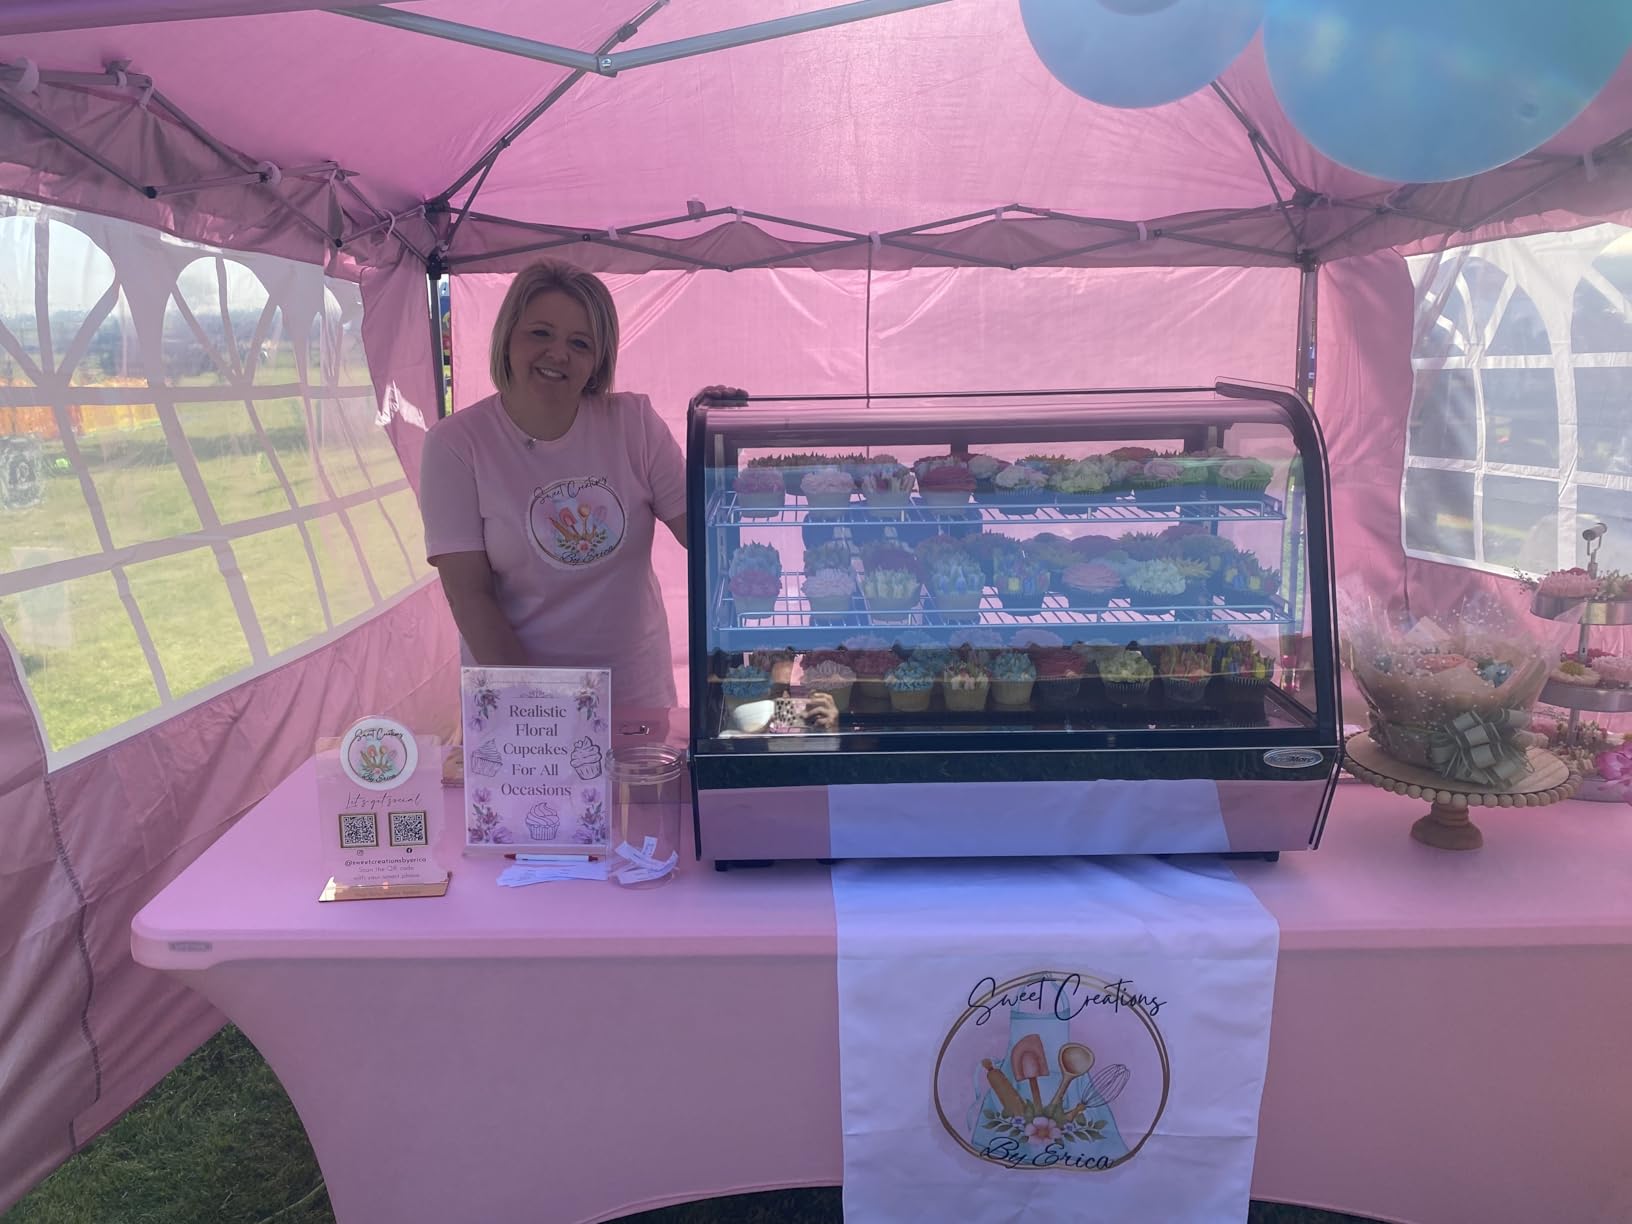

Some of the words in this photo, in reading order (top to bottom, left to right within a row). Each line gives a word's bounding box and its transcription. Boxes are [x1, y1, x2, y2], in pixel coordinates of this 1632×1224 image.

[533, 484, 566, 505] Sweet
[509, 704, 568, 718] Realistic
[516, 723, 558, 737] Floral
[503, 742, 568, 758] Cupcakes
[512, 763, 537, 776] For
[540, 763, 559, 776] All
[501, 783, 572, 796] Occasions
[967, 976, 1057, 1026] Sweet
[1053, 973, 1168, 1022] Creations
[979, 1136, 1026, 1169] By
[1031, 1142, 1115, 1170] Erica
